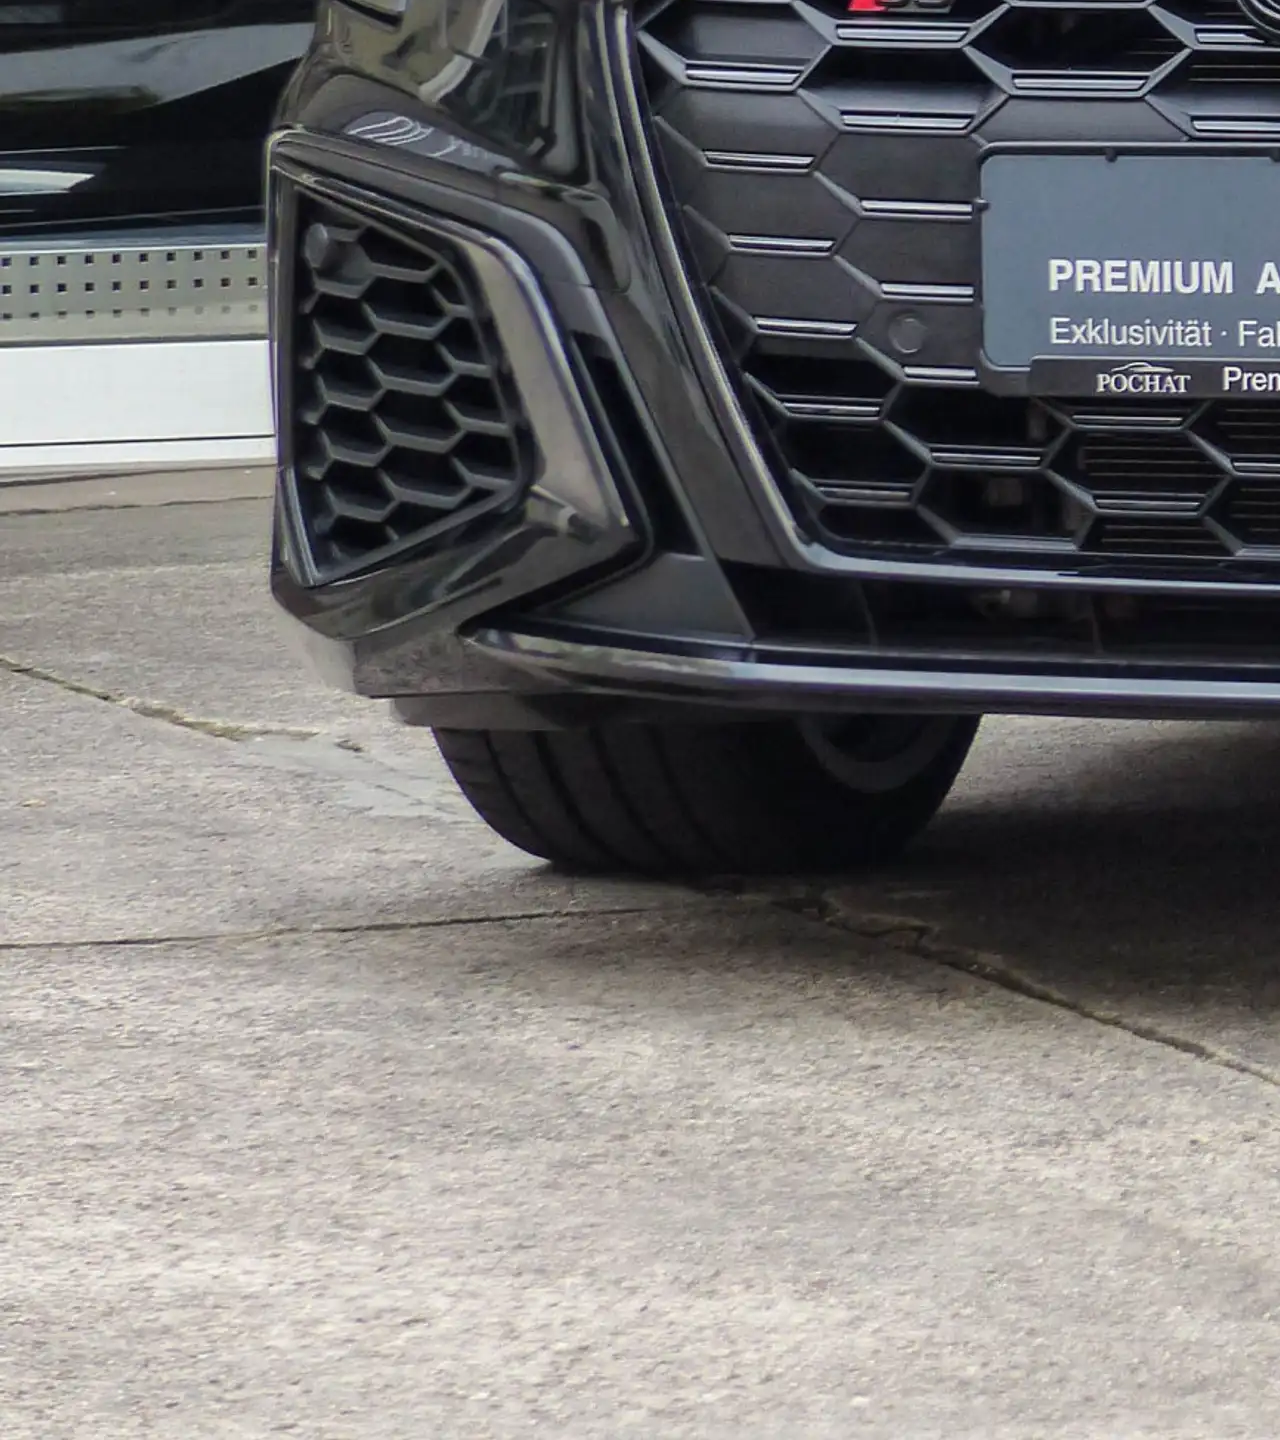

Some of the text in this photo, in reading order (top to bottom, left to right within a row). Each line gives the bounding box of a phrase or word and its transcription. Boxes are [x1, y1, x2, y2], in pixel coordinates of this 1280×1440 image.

[1048, 258, 1234, 294] PREMIUM
[1050, 317, 1213, 348] Exklusivität
[1096, 373, 1192, 393] POCHAT
